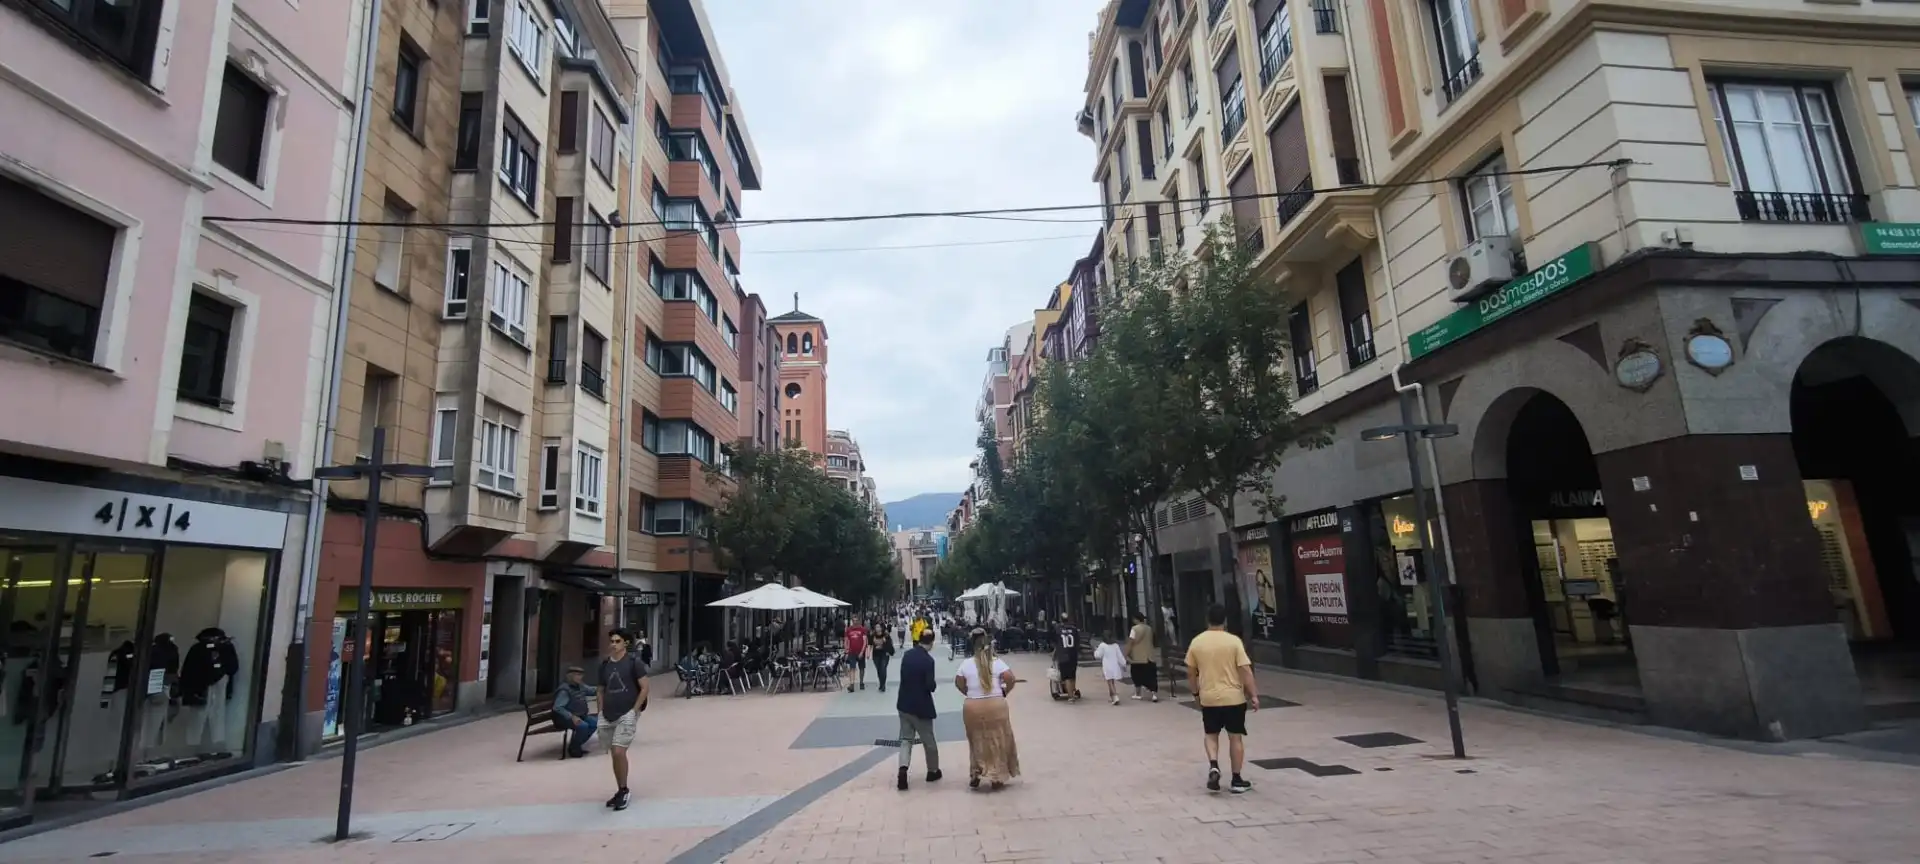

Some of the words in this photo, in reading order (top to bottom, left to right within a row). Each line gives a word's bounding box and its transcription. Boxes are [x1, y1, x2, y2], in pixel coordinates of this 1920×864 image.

[1480, 258, 1567, 314] DOSmasDOS
[1550, 276, 1569, 289] obras
[1308, 580, 1342, 594] REVISIÓN
[378, 593, 403, 603] YVES
[405, 593, 443, 603] ROCHER
[1310, 596, 1344, 609] GRATUITA
[1061, 634, 1074, 648] 10
